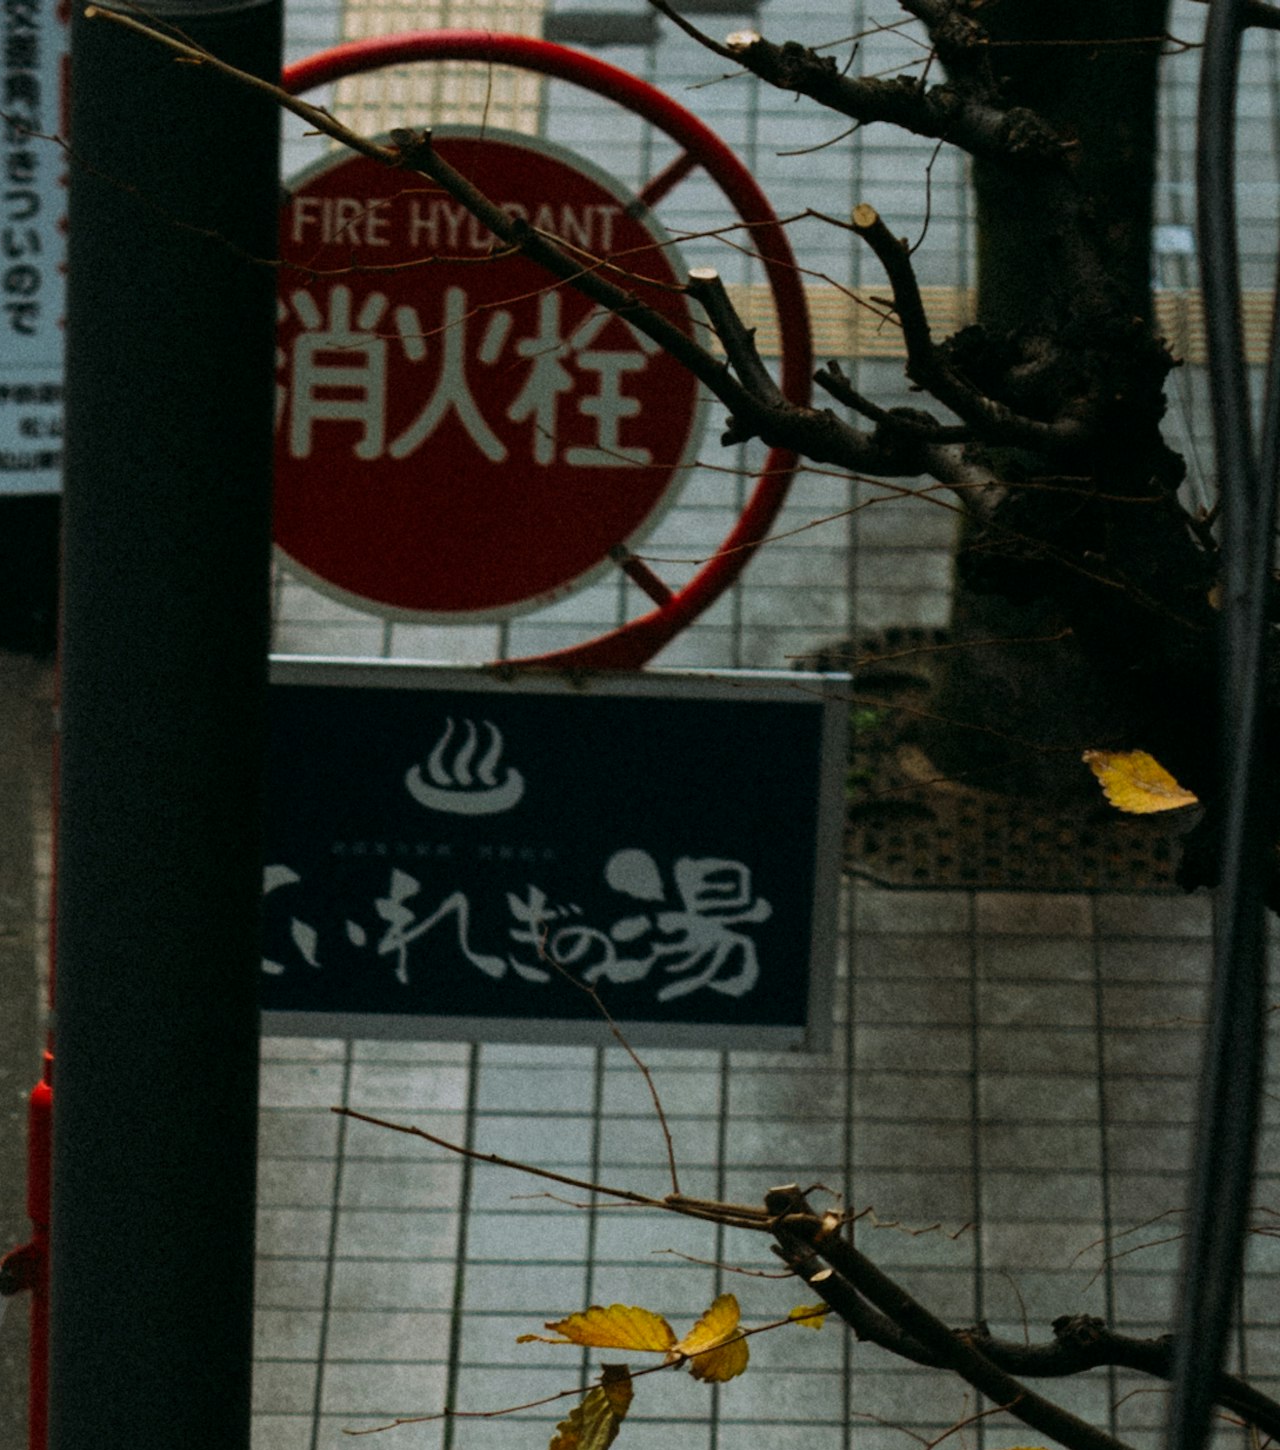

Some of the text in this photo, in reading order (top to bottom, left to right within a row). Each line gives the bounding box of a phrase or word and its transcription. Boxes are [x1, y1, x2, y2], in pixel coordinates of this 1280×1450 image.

[291, 197, 392, 247] FIRE
[276, 286, 662, 467] 消火栓
